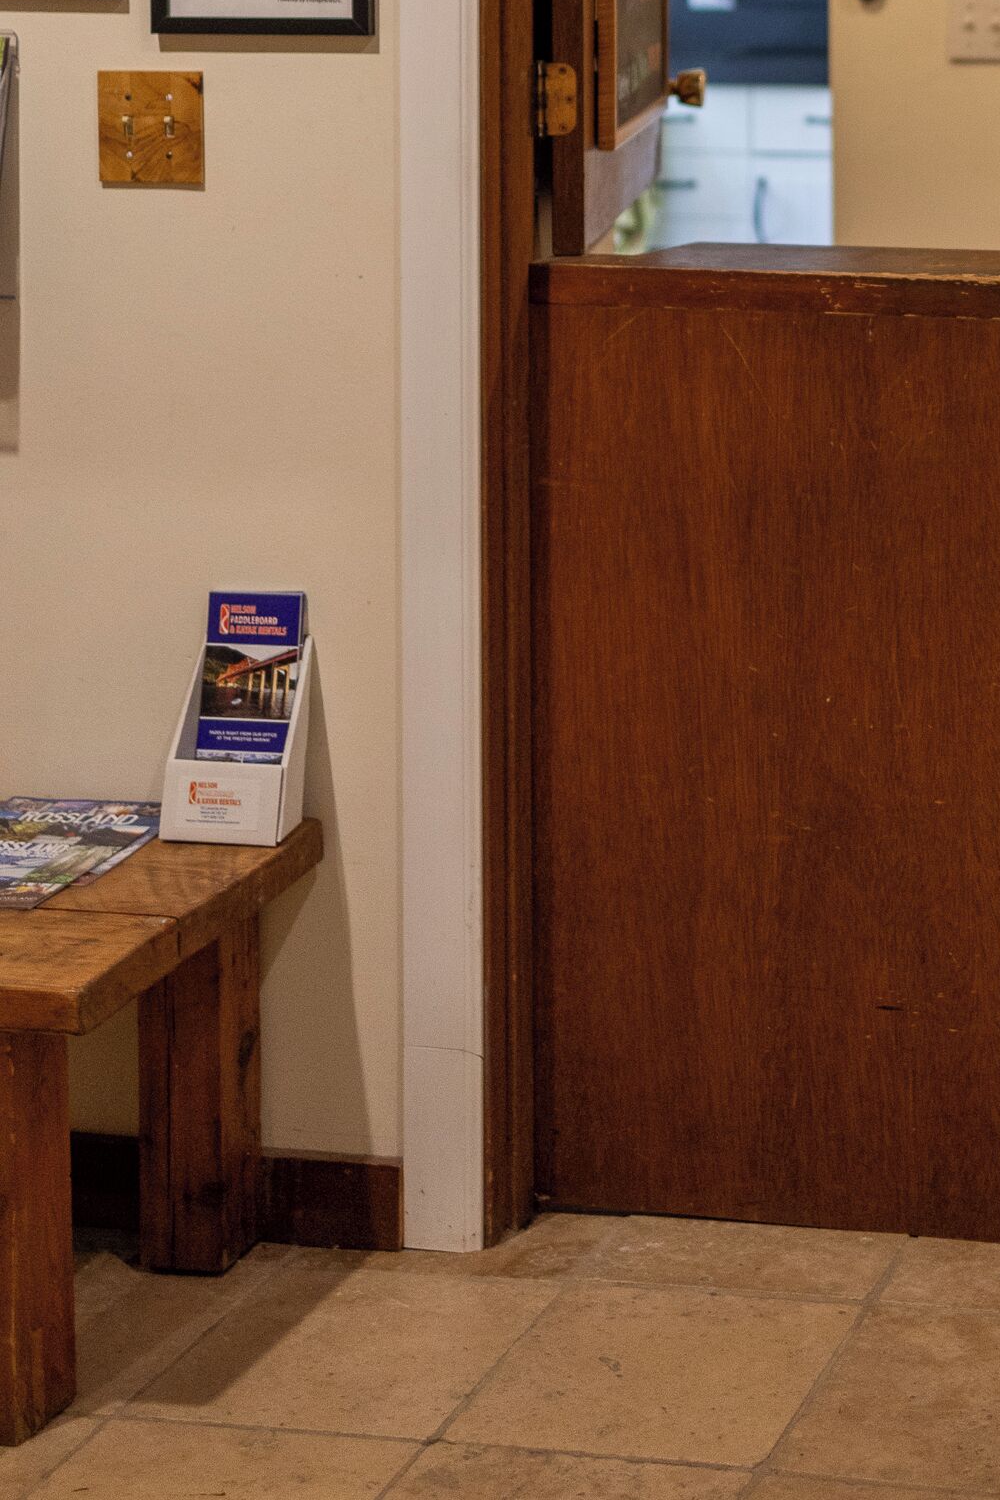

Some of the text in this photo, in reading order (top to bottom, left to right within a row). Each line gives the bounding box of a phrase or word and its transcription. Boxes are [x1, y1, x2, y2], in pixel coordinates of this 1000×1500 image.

[230, 615, 278, 625] PADDLEBOARD
[18, 811, 139, 825] ROSSLAND
[0, 840, 71, 855] SSLAND
